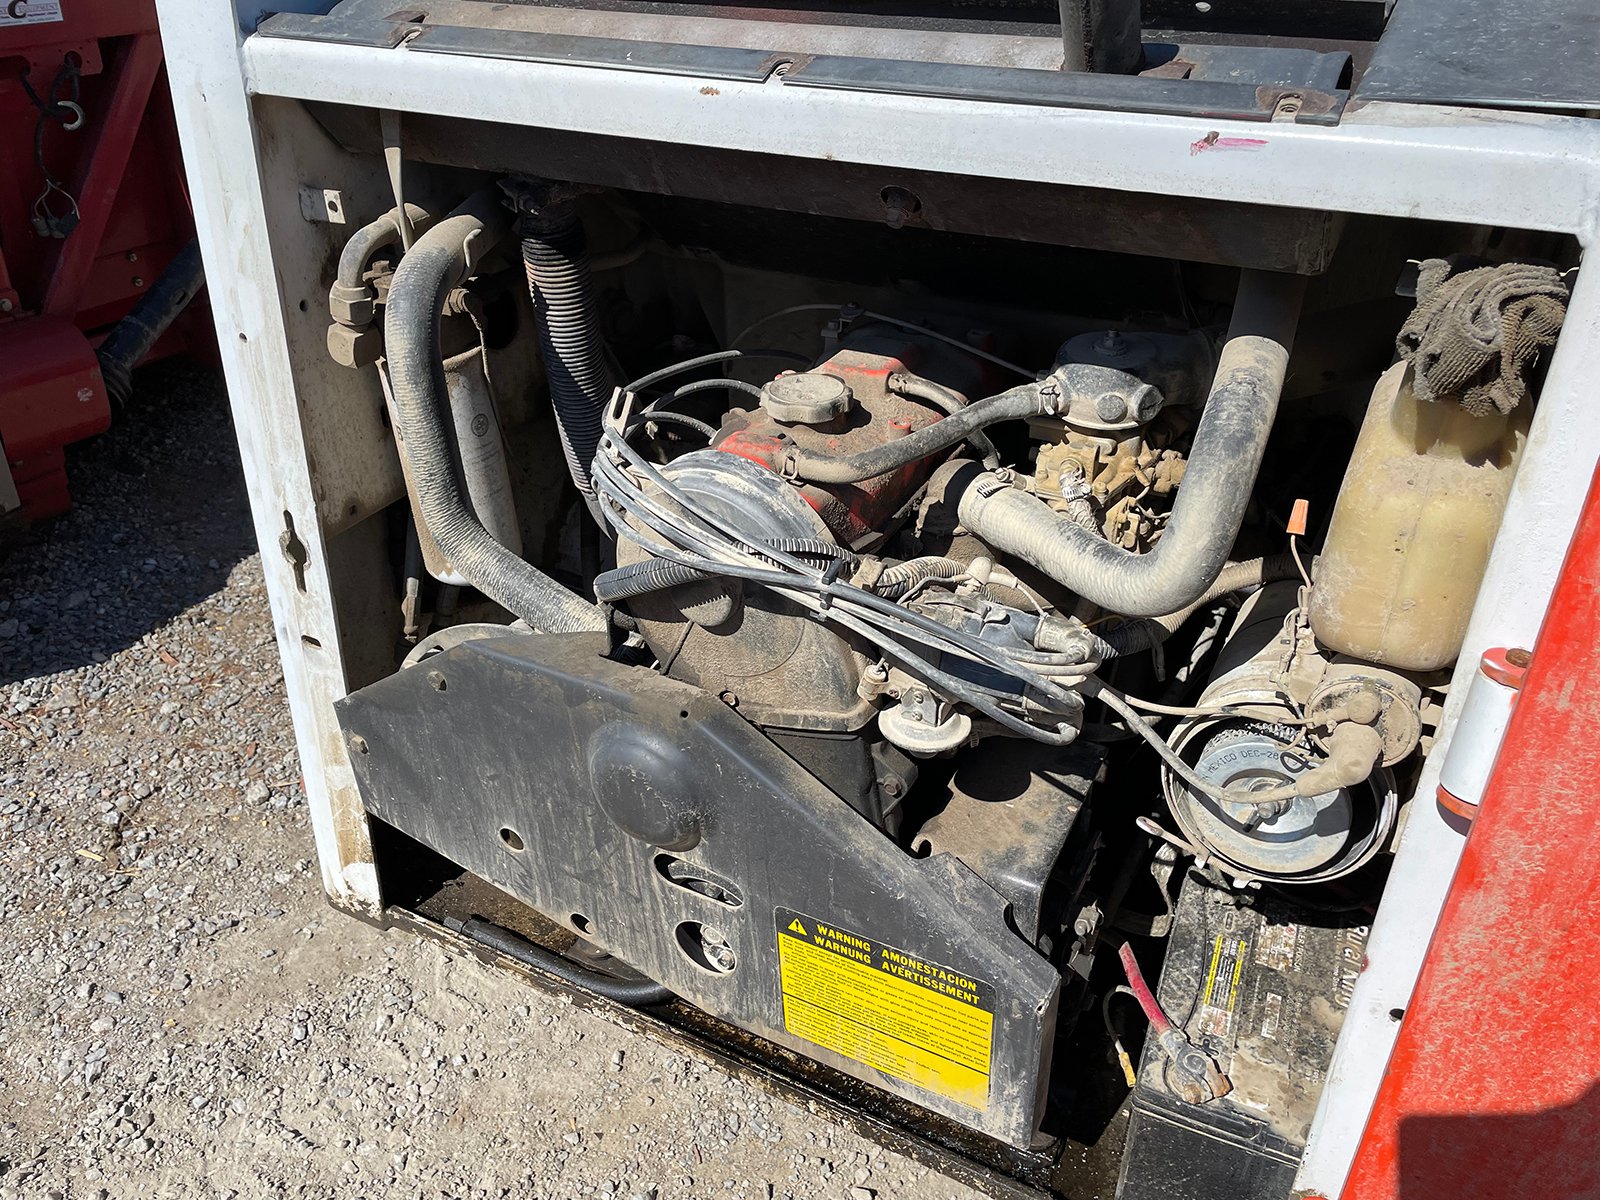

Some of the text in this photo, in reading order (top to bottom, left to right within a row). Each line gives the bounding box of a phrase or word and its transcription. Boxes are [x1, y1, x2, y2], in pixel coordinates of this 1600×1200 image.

[1207, 753, 1237, 774] MEXICO
[813, 935, 980, 1005] WARNUNG AVERTISSEMENT
[816, 924, 977, 992] WARNING AMONESTACION
